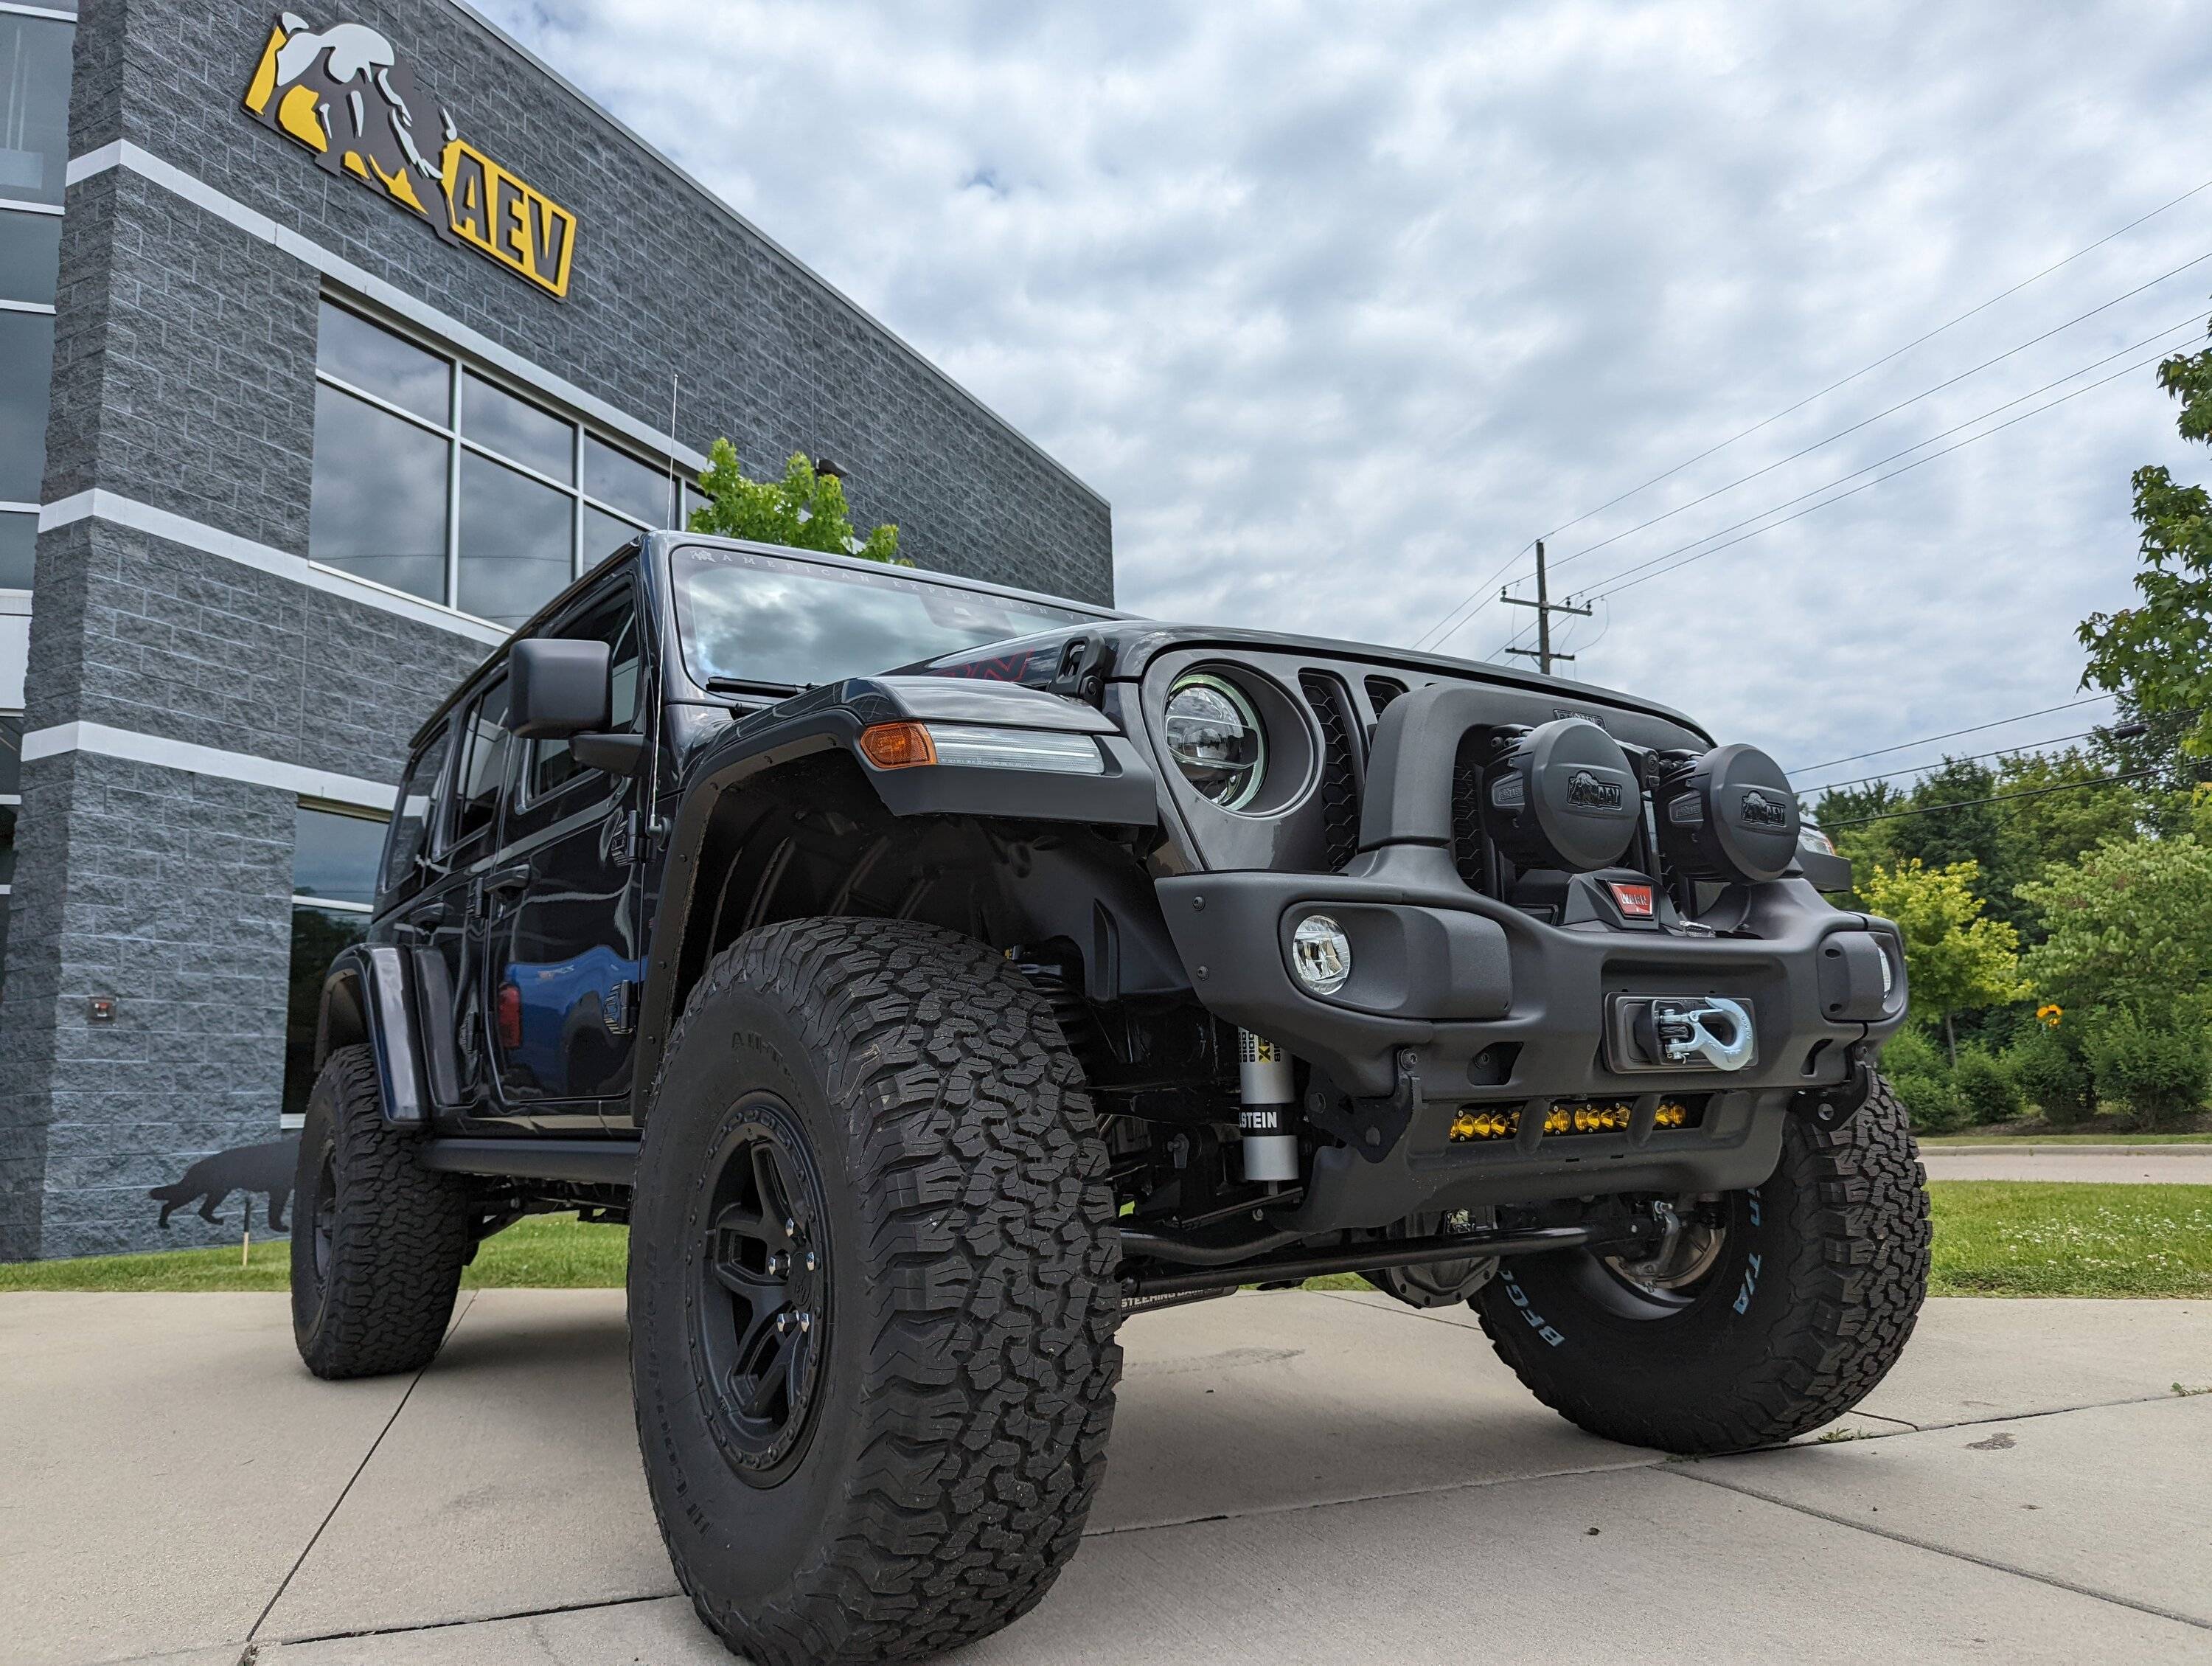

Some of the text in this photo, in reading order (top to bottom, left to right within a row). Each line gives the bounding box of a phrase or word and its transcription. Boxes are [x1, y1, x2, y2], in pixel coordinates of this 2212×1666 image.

[452, 149, 567, 285] AEV
[723, 554, 1048, 614] AMERICAN EXPEDITION
